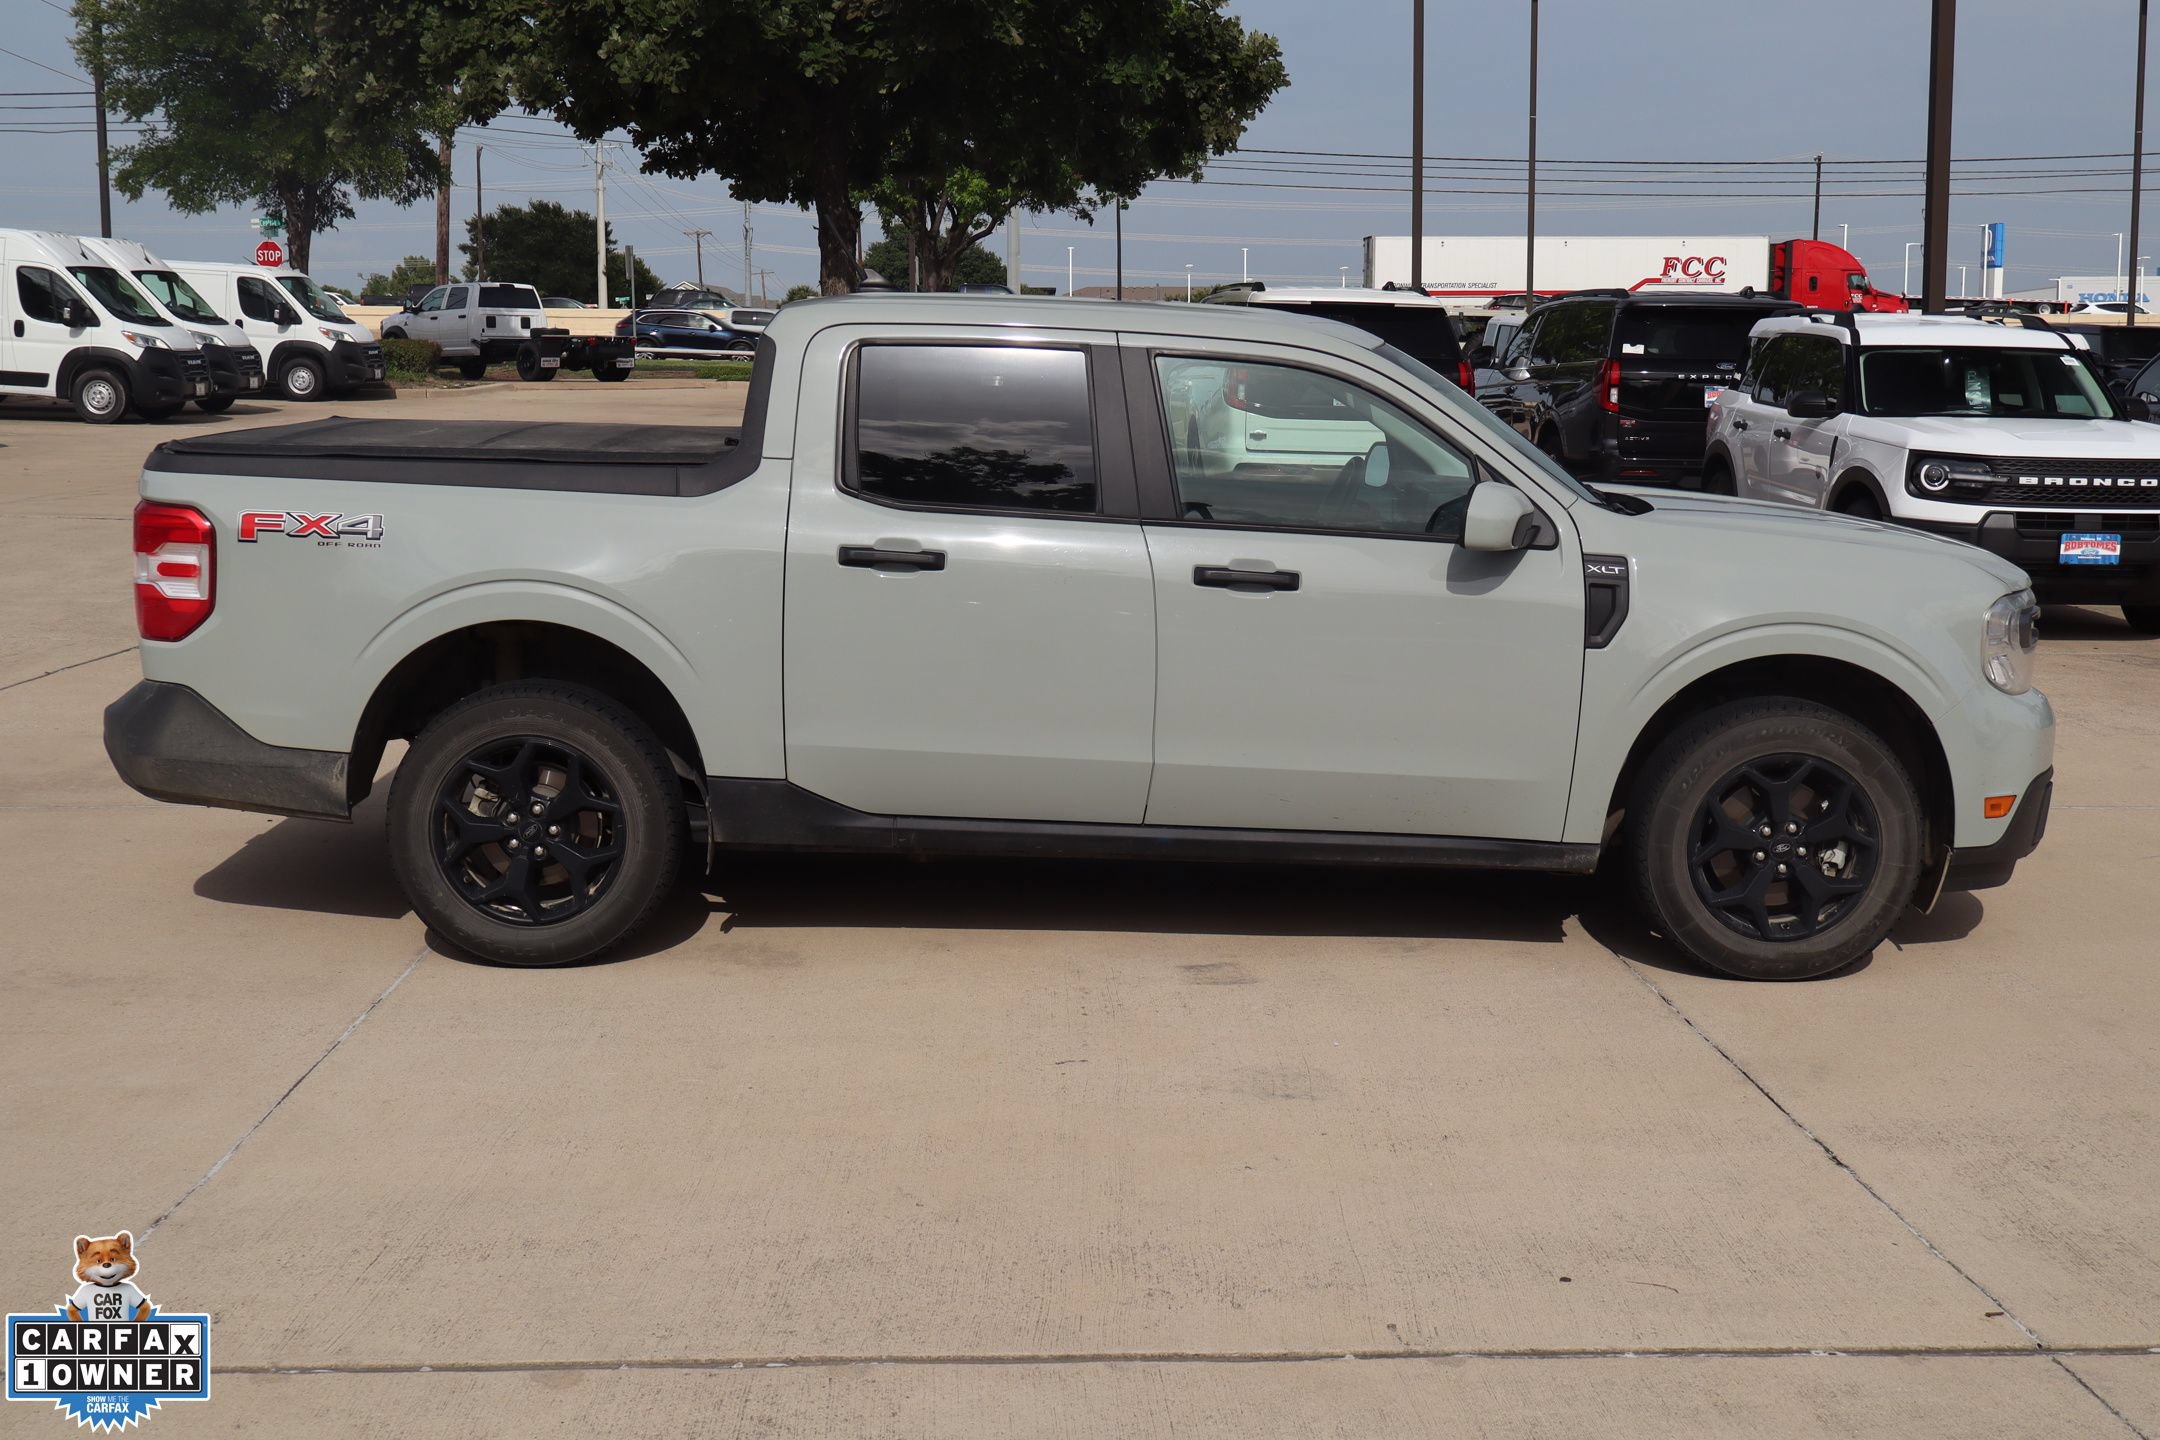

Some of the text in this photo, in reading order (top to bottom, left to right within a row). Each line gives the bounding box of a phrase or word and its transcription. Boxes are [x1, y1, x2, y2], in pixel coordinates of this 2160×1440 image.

[257, 250, 281, 261] STOP
[1660, 256, 1727, 278] FCC
[2019, 476, 2158, 487] BRONCO
[238, 510, 384, 543] FX4
[1587, 564, 1625, 575] XLT
